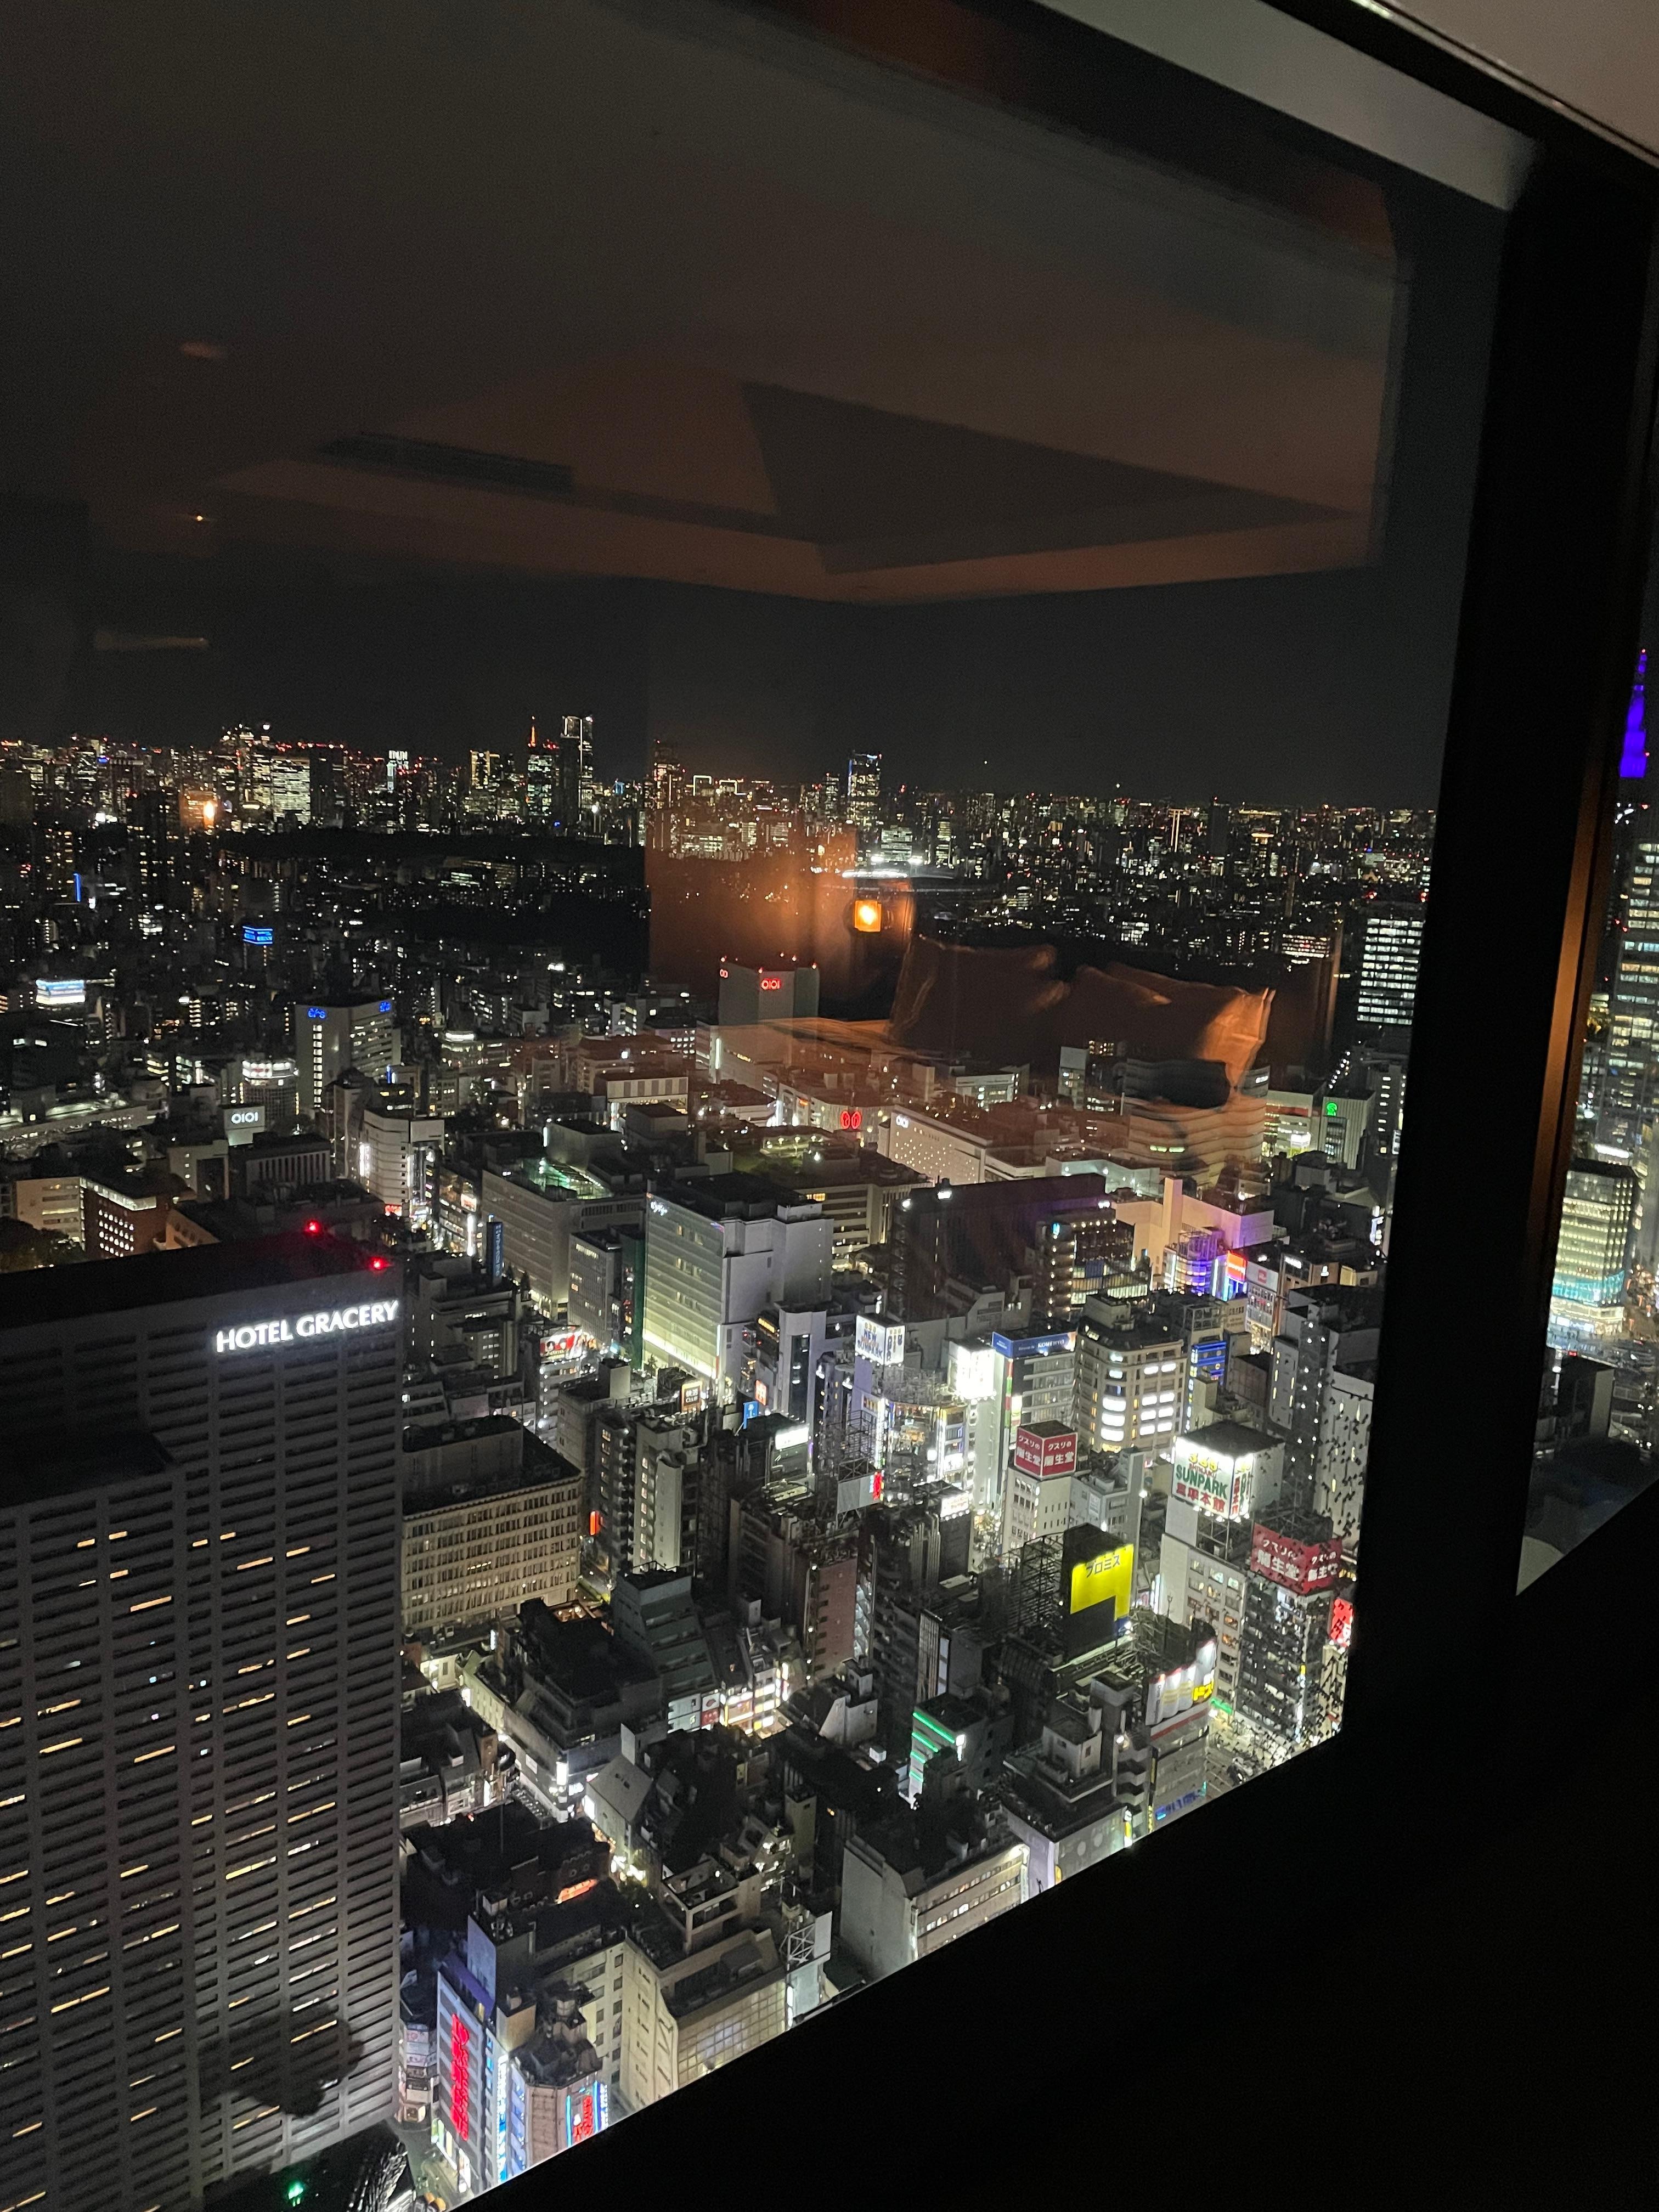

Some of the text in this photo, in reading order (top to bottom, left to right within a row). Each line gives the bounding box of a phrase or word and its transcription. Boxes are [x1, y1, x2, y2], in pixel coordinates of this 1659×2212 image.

[216, 1300, 399, 1353] HOTEL GRACERY
[1019, 1435, 1041, 1449] クスリの
[1048, 1441, 1072, 1451] クスリの
[1176, 1464, 1228, 1500] SUNPARK
[1086, 1555, 1120, 1578] プロミス
